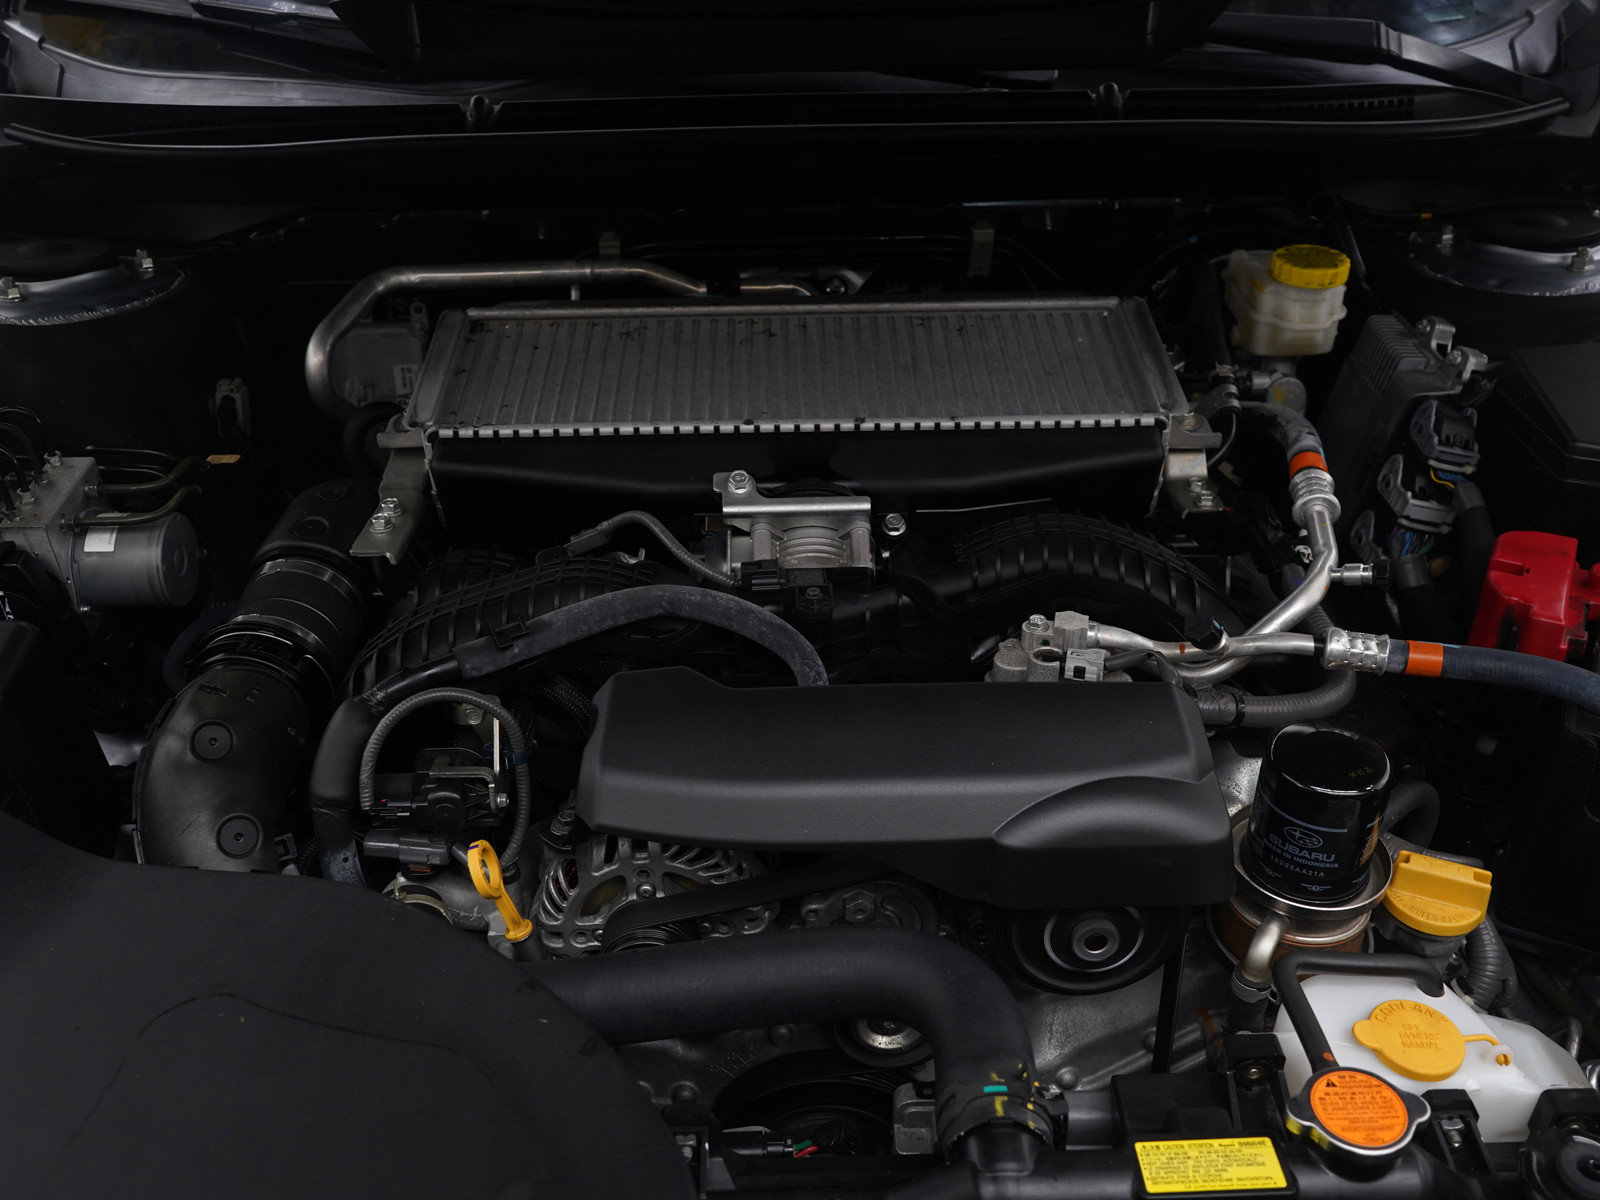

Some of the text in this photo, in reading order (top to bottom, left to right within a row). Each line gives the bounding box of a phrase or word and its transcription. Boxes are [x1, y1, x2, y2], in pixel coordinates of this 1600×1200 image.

[1263, 838, 1339, 869] MADE IN INDONESIA
[1268, 833, 1336, 862] SUBARU
[1374, 1001, 1449, 1023] COOLANT
